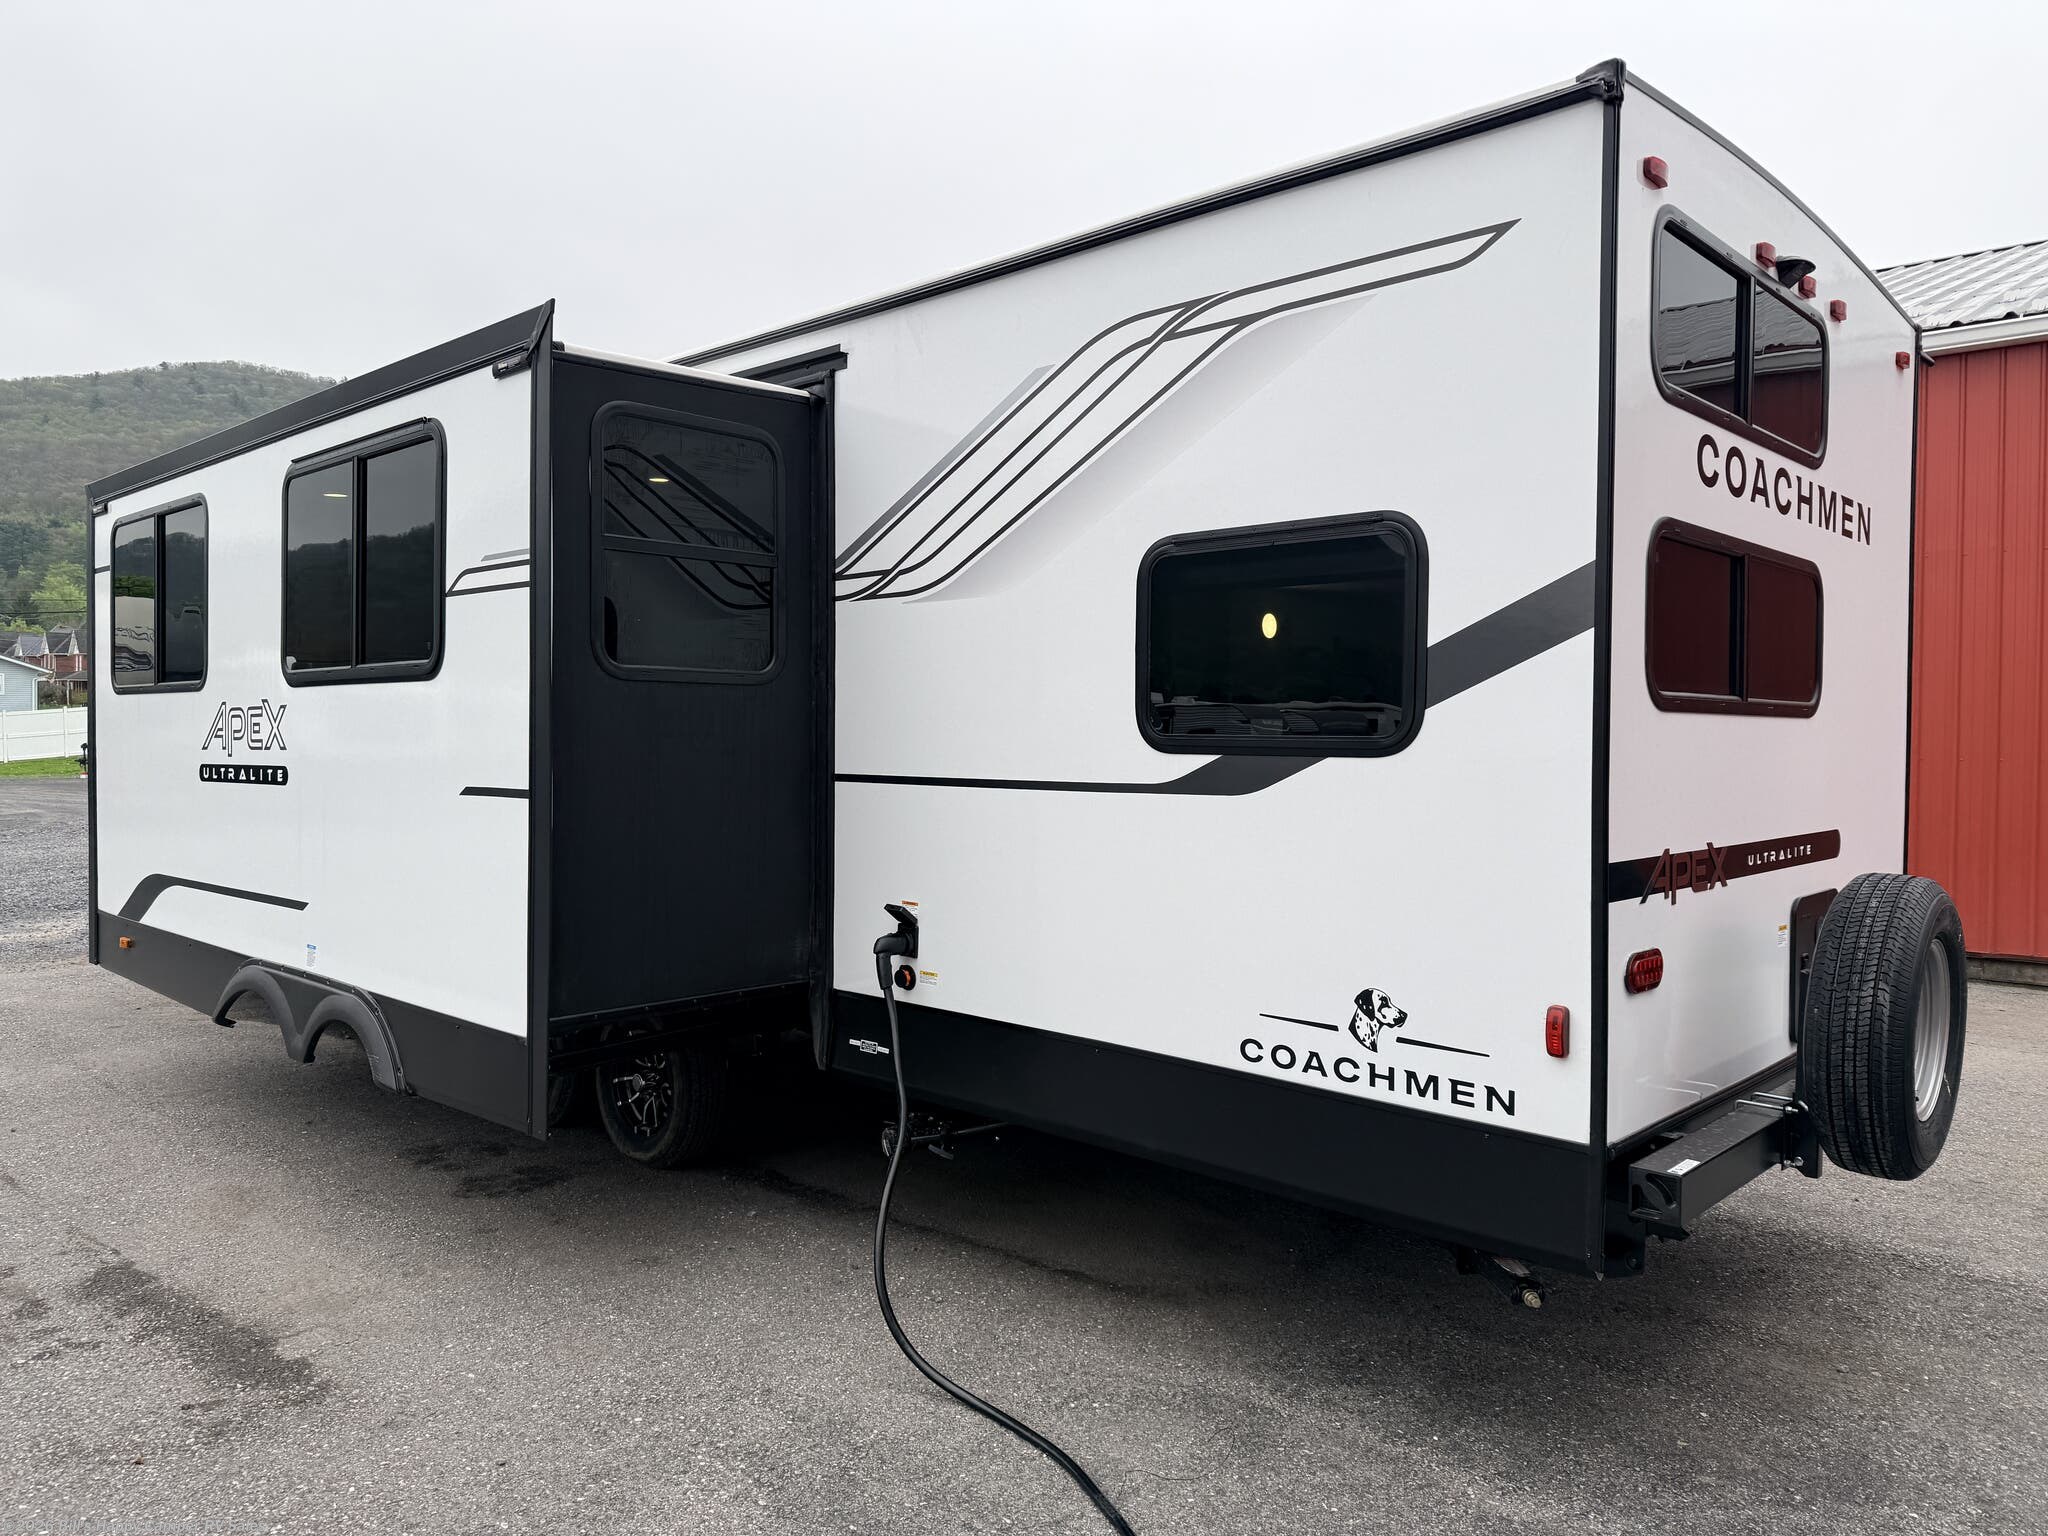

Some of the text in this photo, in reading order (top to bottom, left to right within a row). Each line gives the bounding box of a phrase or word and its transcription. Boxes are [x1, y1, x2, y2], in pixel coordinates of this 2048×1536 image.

[1697, 433, 1872, 546] COACHMEN
[201, 698, 288, 758] APEX
[202, 766, 284, 783] ULTRALITE
[1639, 841, 1813, 906] APEX ULTRALITE
[1239, 1038, 1516, 1117] COACHMEN
